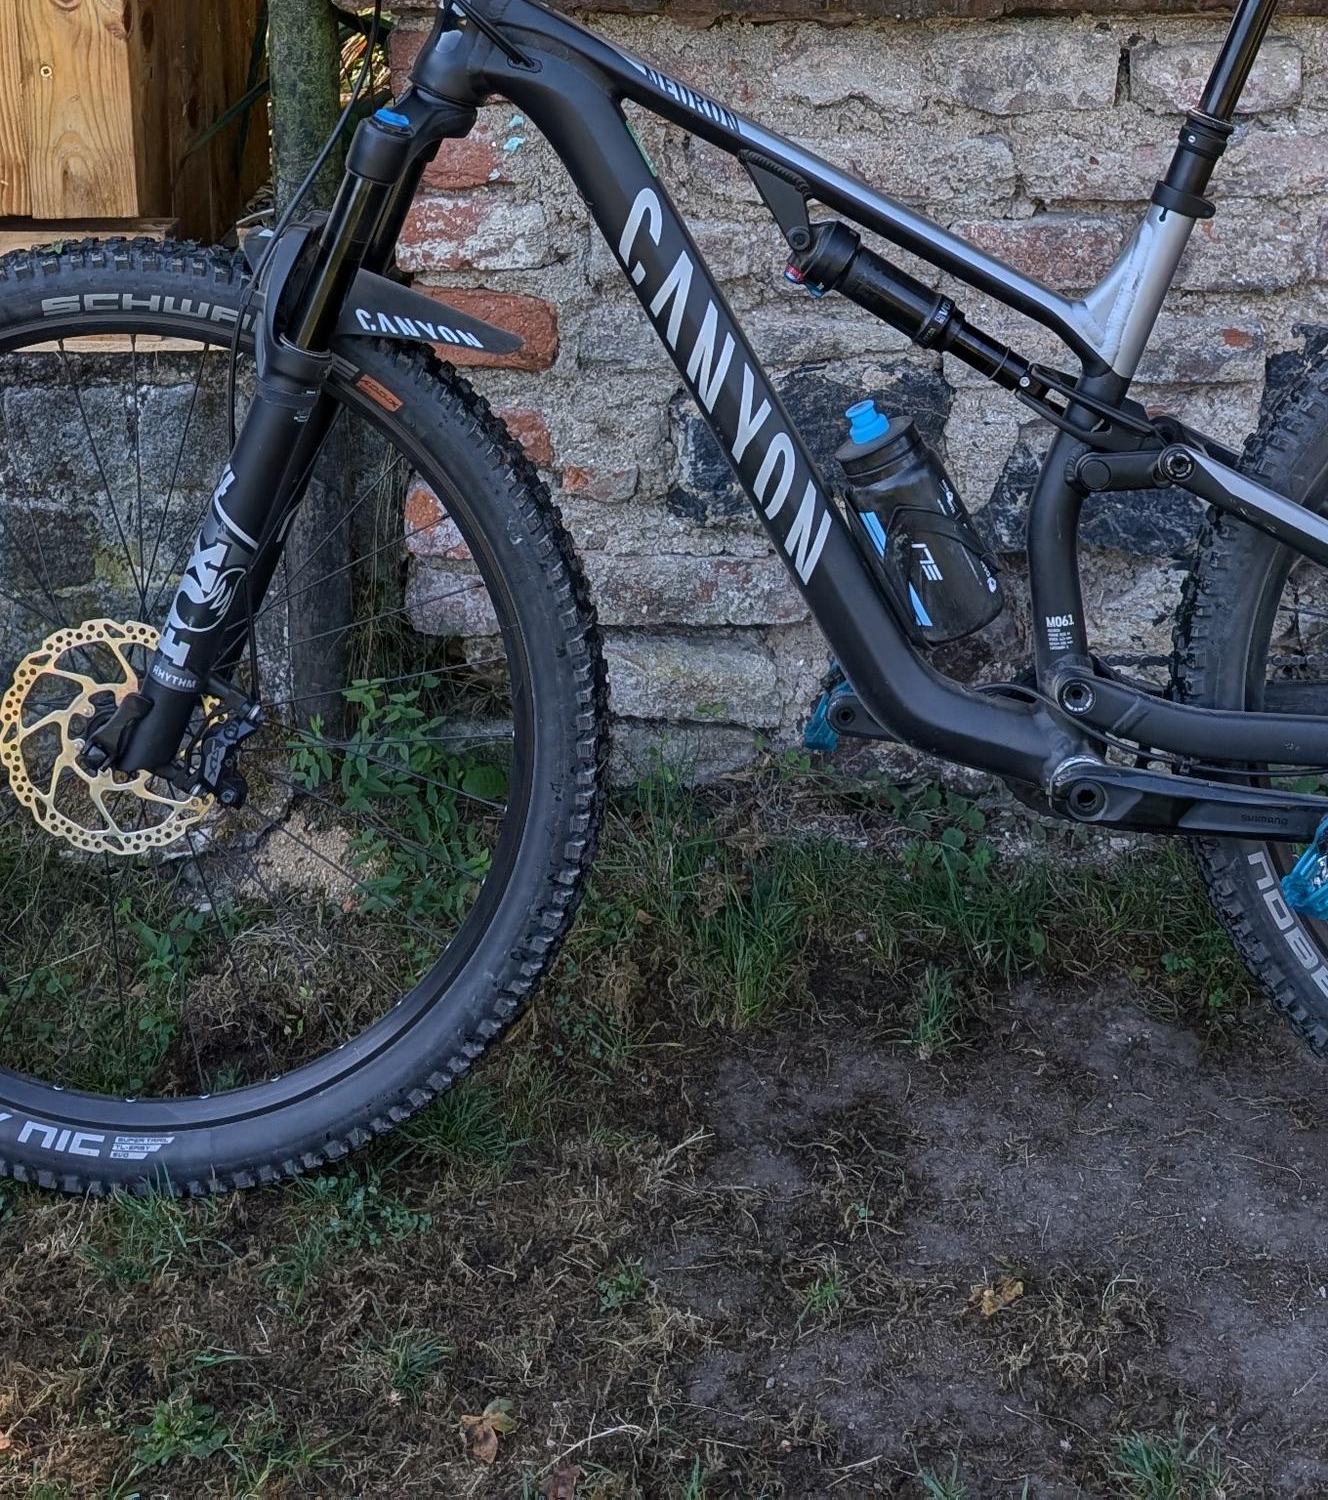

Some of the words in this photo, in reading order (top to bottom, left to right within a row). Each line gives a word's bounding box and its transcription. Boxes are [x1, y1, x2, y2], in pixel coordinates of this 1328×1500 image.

[355, 308, 484, 348] CANYON
[619, 188, 832, 586] CANYON
[152, 665, 197, 693] RHYTHM
[17, 1120, 105, 1157] NIC
